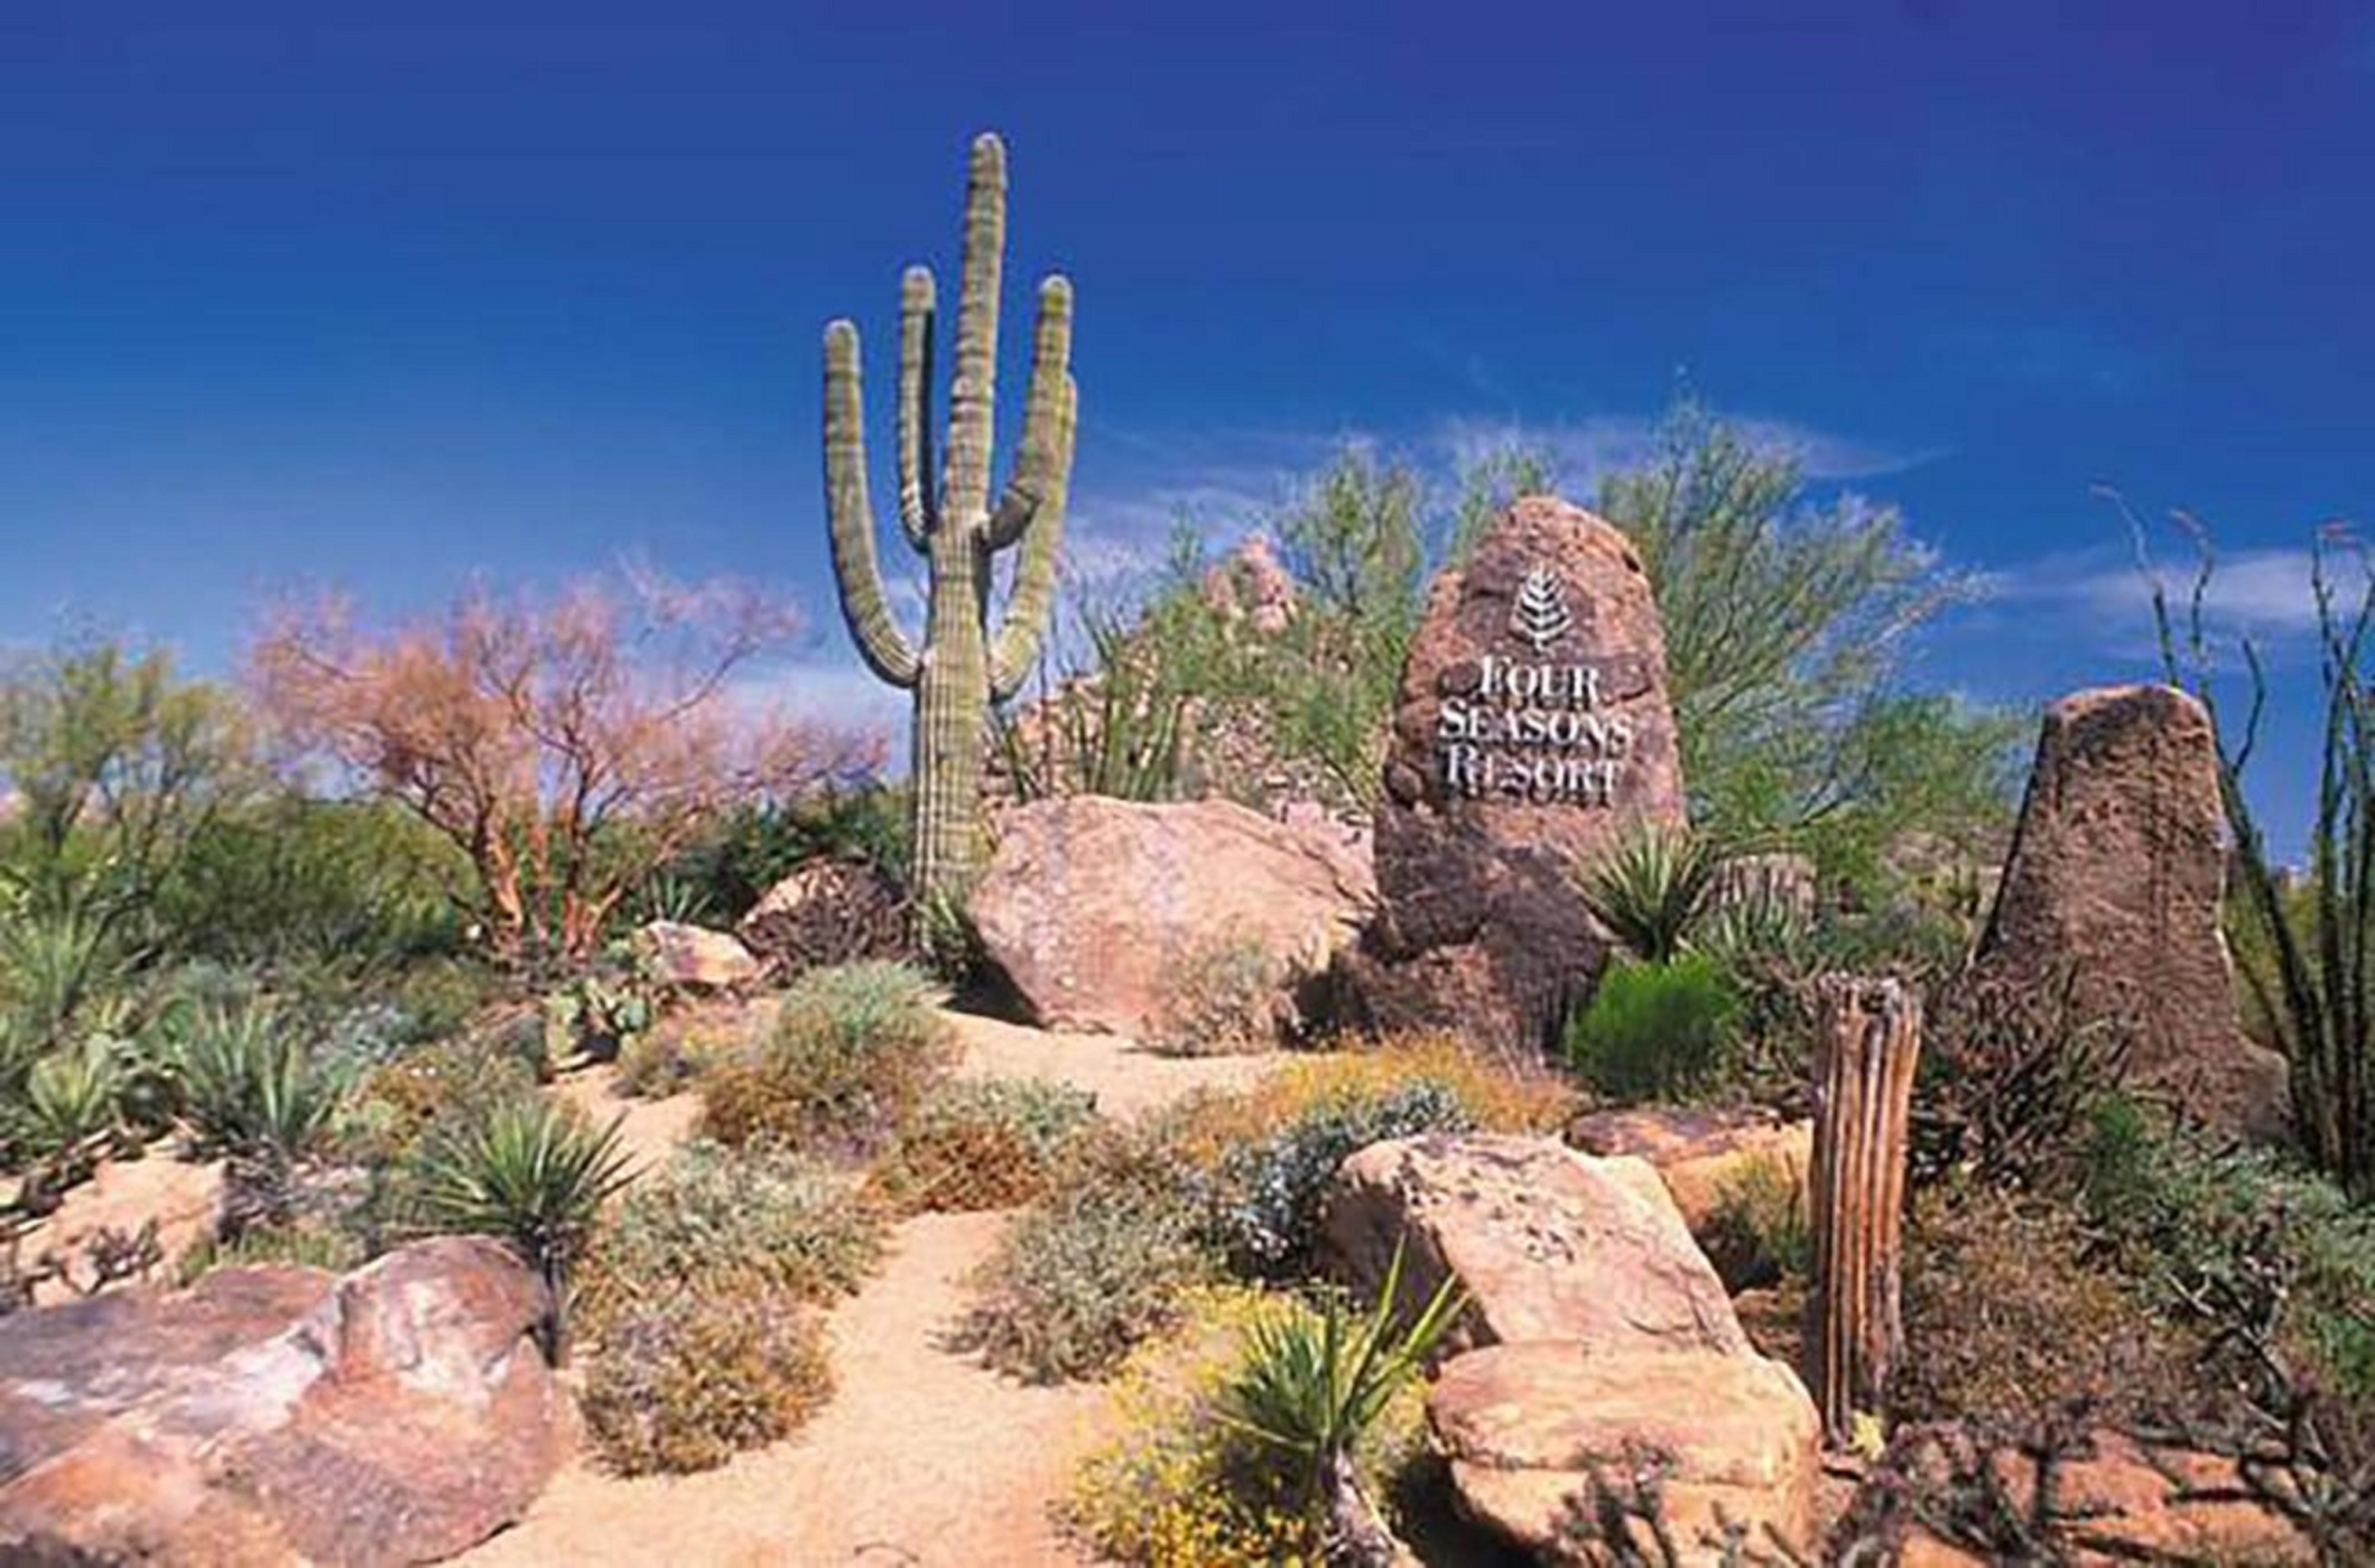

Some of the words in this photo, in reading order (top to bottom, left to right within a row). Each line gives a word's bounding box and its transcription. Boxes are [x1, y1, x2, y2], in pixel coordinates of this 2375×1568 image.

[1479, 655, 1603, 704] FOUR
[1439, 695, 1634, 752] SEASONS
[1447, 743, 1625, 796] RESORT
